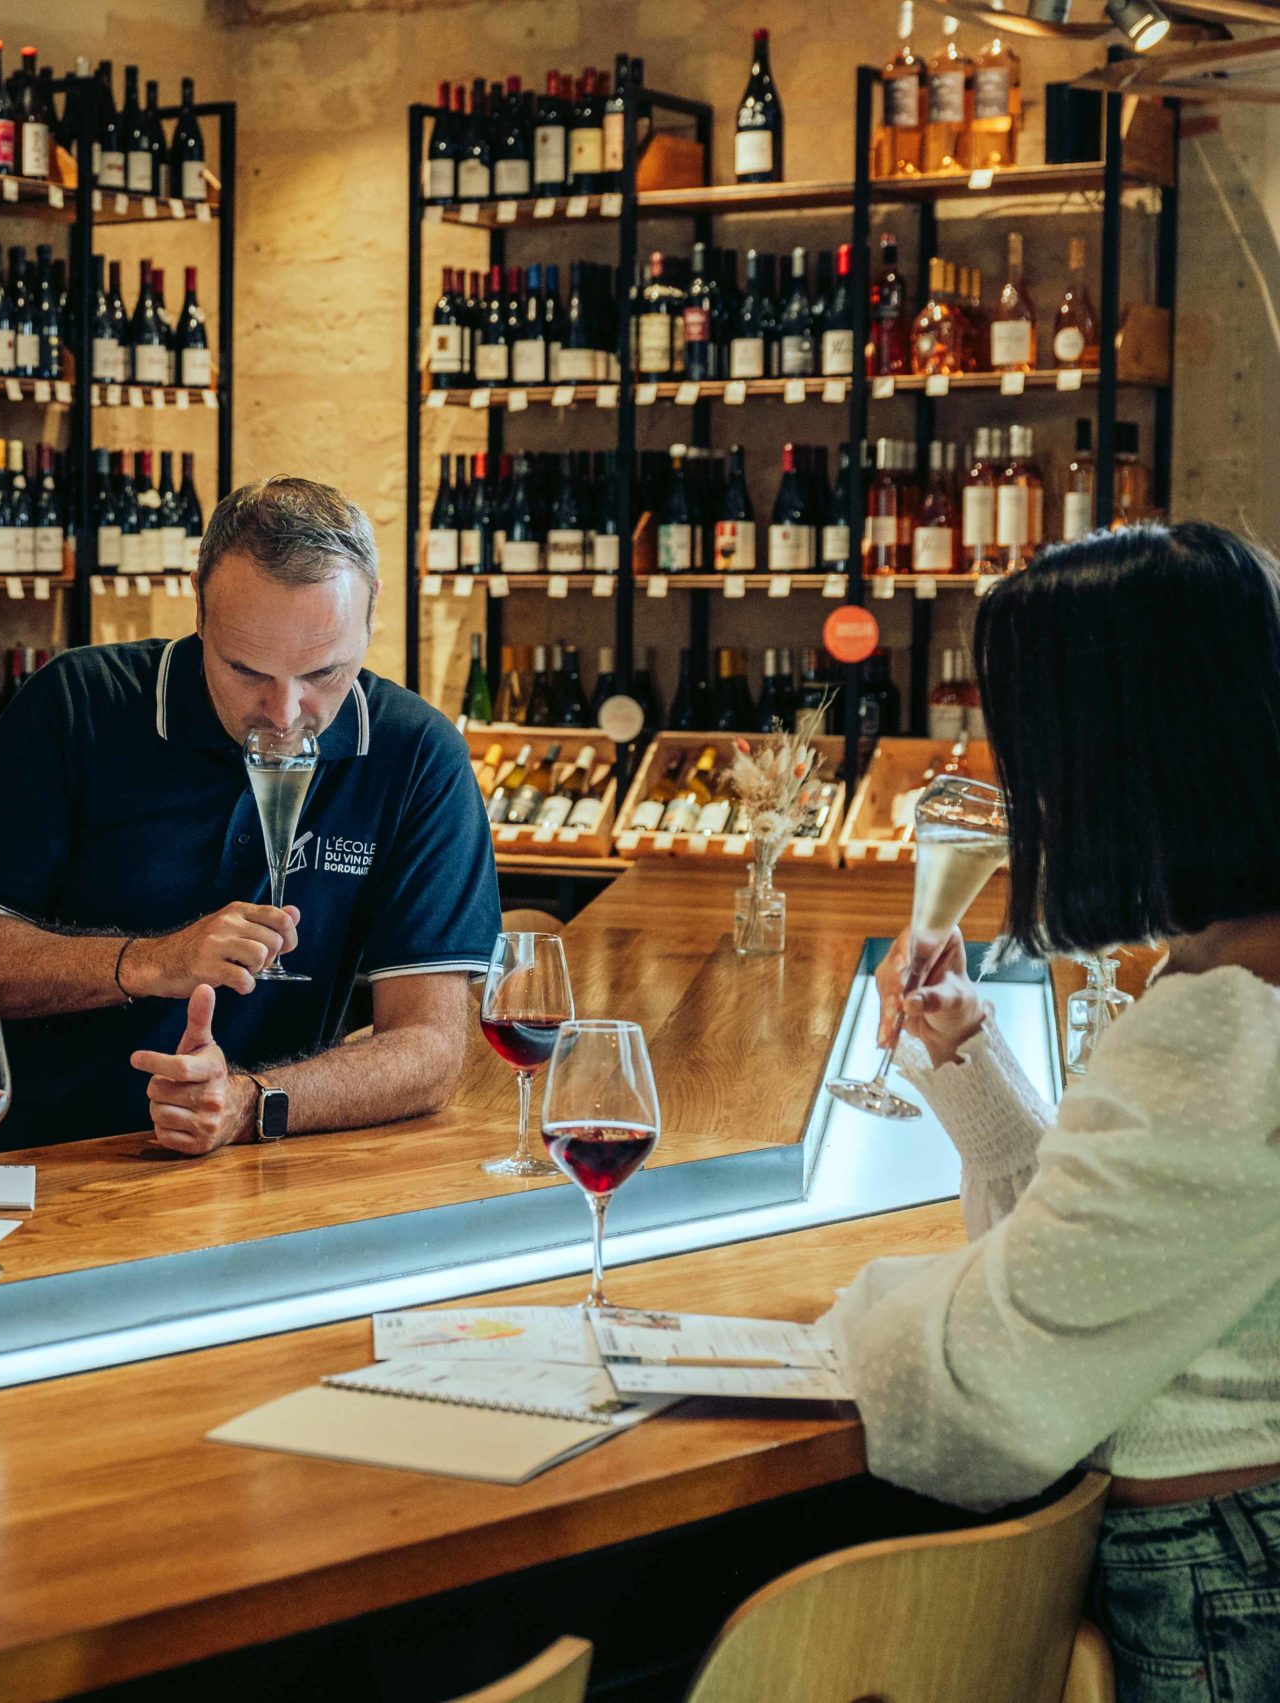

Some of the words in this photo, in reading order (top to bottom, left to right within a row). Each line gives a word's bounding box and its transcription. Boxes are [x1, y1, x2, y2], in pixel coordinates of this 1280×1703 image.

[325, 836, 377, 855] L'ÉCOLE
[325, 851, 342, 862] DU
[343, 853, 362, 865] VIN
[362, 856, 374, 866] DE
[324, 862, 370, 876] BORDEAUX
